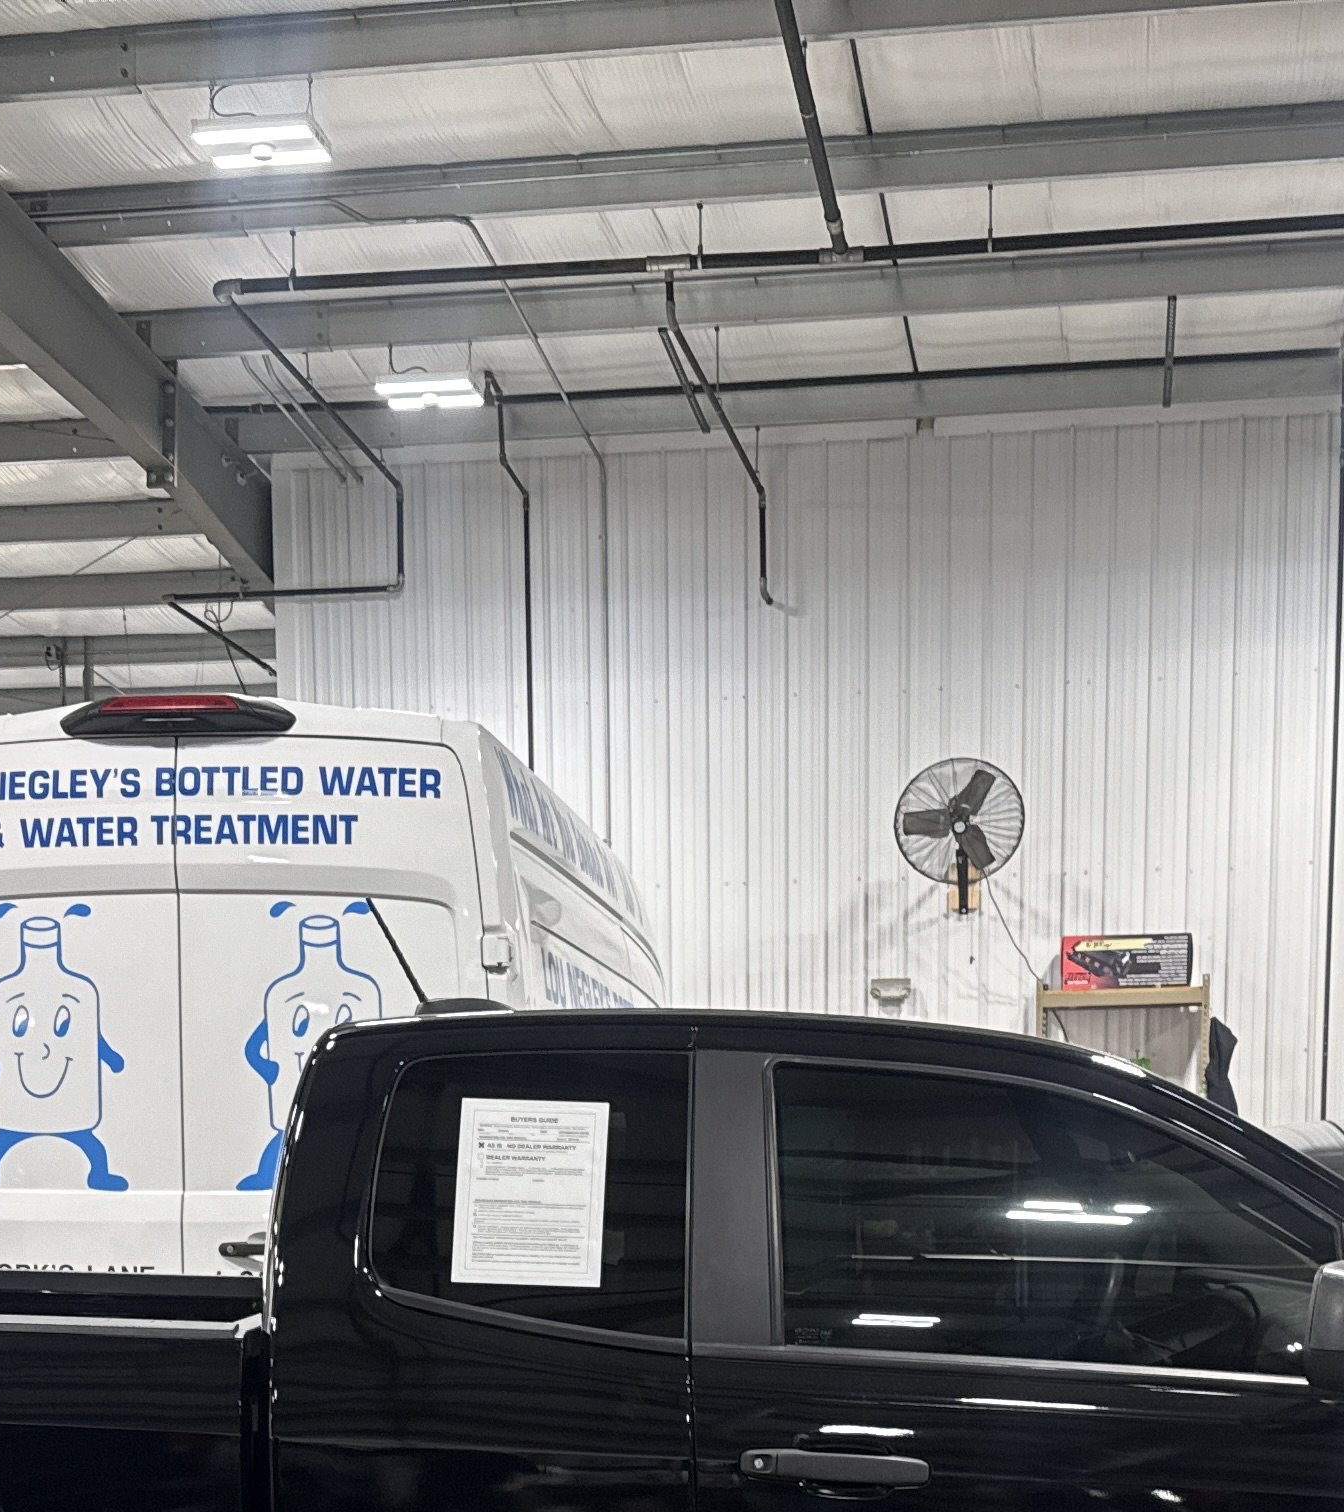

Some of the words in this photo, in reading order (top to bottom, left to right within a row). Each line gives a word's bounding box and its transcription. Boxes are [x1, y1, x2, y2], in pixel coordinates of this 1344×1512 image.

[155, 766, 304, 797] BOTTLED
[318, 766, 442, 799] WATER
[19, 816, 139, 848] WATER
[150, 814, 359, 846] TREATMENT
